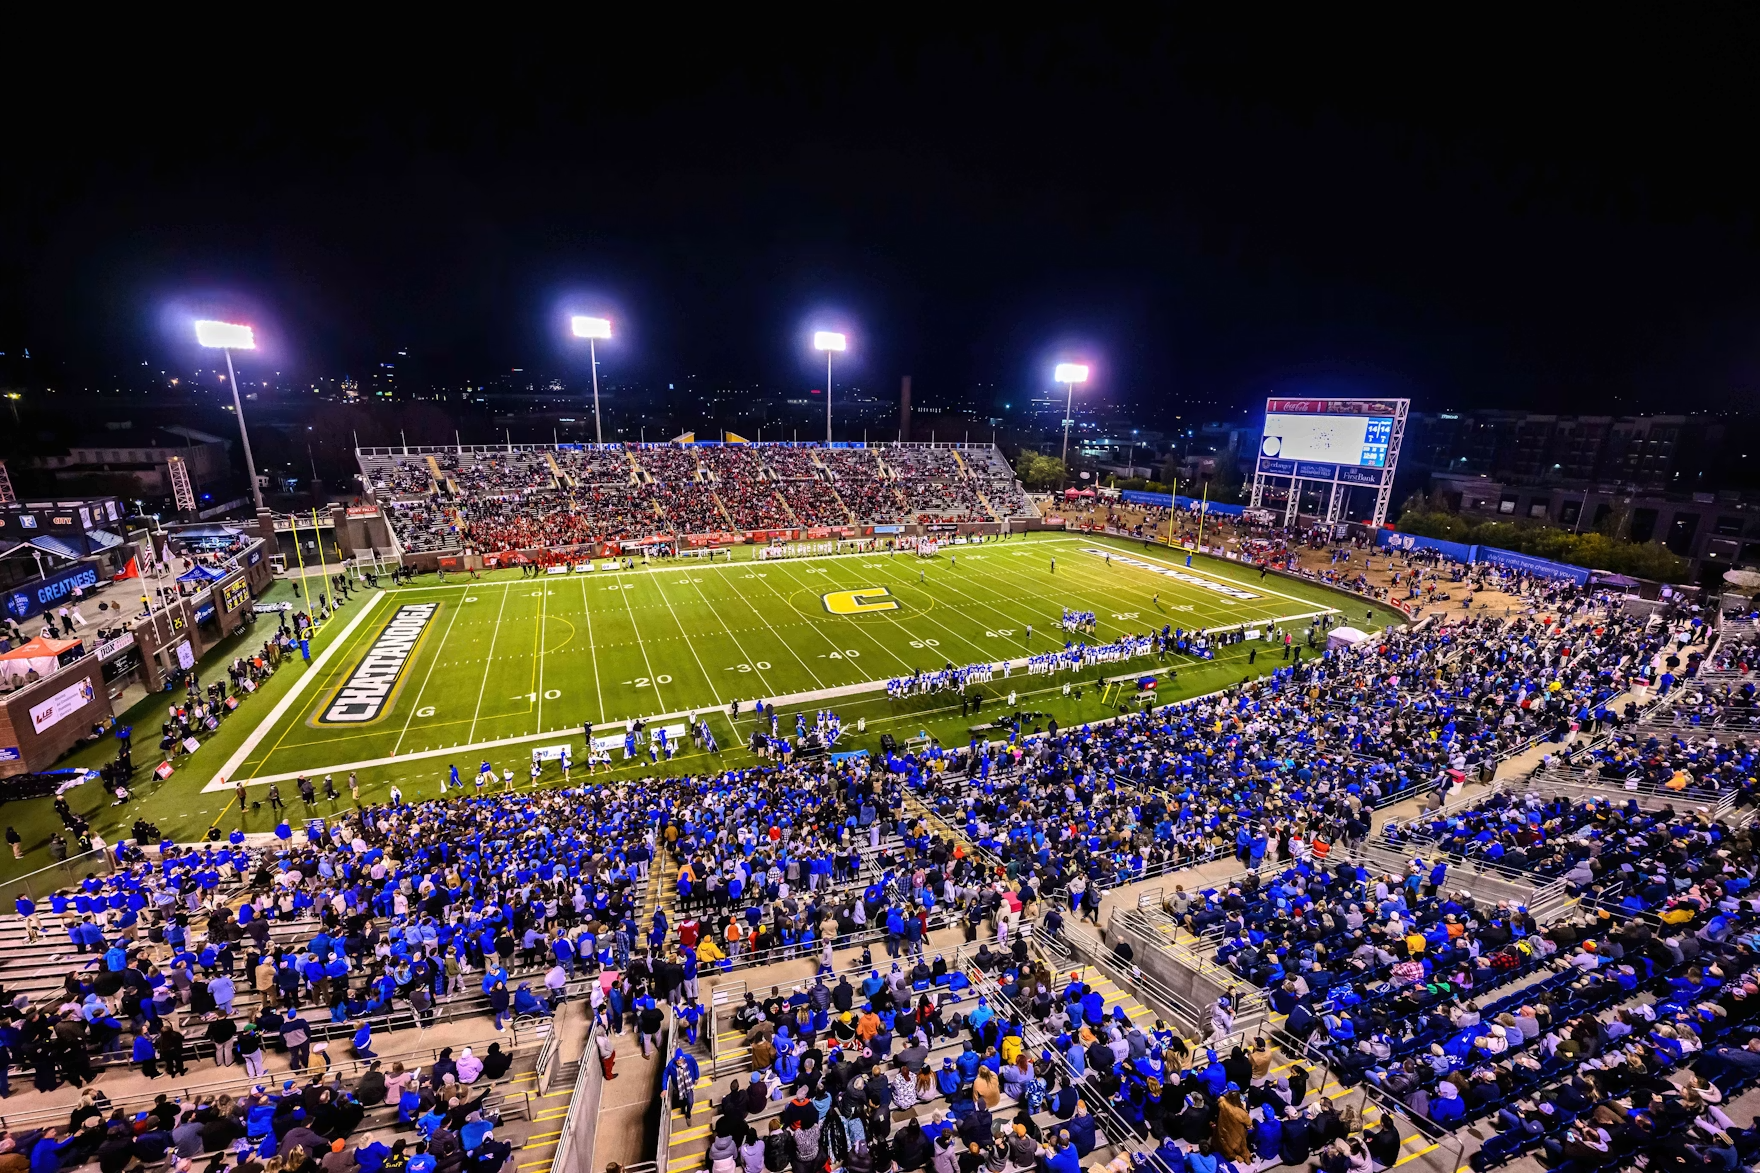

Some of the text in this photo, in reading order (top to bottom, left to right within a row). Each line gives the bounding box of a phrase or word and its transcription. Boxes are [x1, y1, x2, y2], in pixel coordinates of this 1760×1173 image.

[1343, 472, 1376, 483] FirstBank
[53, 517, 72, 525] CITY
[1487, 553, 1504, 562] We're
[1505, 557, 1520, 566] right
[1520, 560, 1534, 569] here
[1534, 563, 1558, 576] cheering
[37, 569, 97, 604] GREATNESS
[822, 587, 900, 615] C
[173, 617, 183, 630] 25
[985, 629, 1013, 638] 40
[909, 638, 940, 649] 50
[828, 649, 860, 660] 40
[325, 602, 437, 721] CHATTANOOGA
[735, 661, 772, 673] 30
[634, 674, 673, 688] 20
[524, 689, 562, 702] 10
[42, 706, 53, 718] LEE
[416, 706, 436, 718] G
